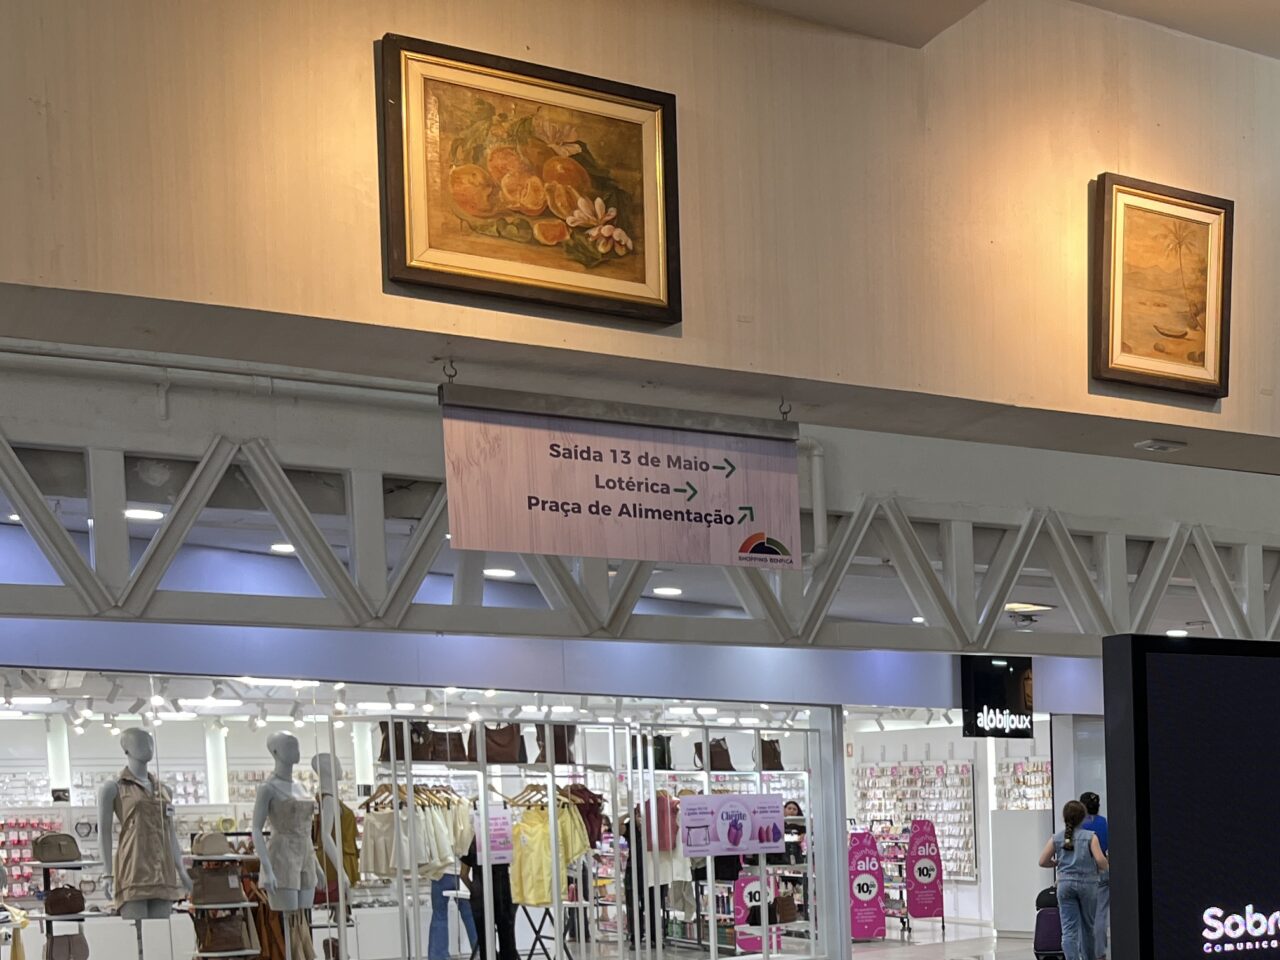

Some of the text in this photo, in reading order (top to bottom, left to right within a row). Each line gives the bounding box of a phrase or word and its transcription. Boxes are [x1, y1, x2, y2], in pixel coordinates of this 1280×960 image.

[549, 443, 710, 473] Saída 13 de Maio
[595, 474, 671, 496] Lotérica
[527, 495, 734, 527] Praça de Alimentação
[976, 705, 1031, 733] alôbijoux
[918, 843, 938, 856] alô
[857, 856, 879, 871] alô
